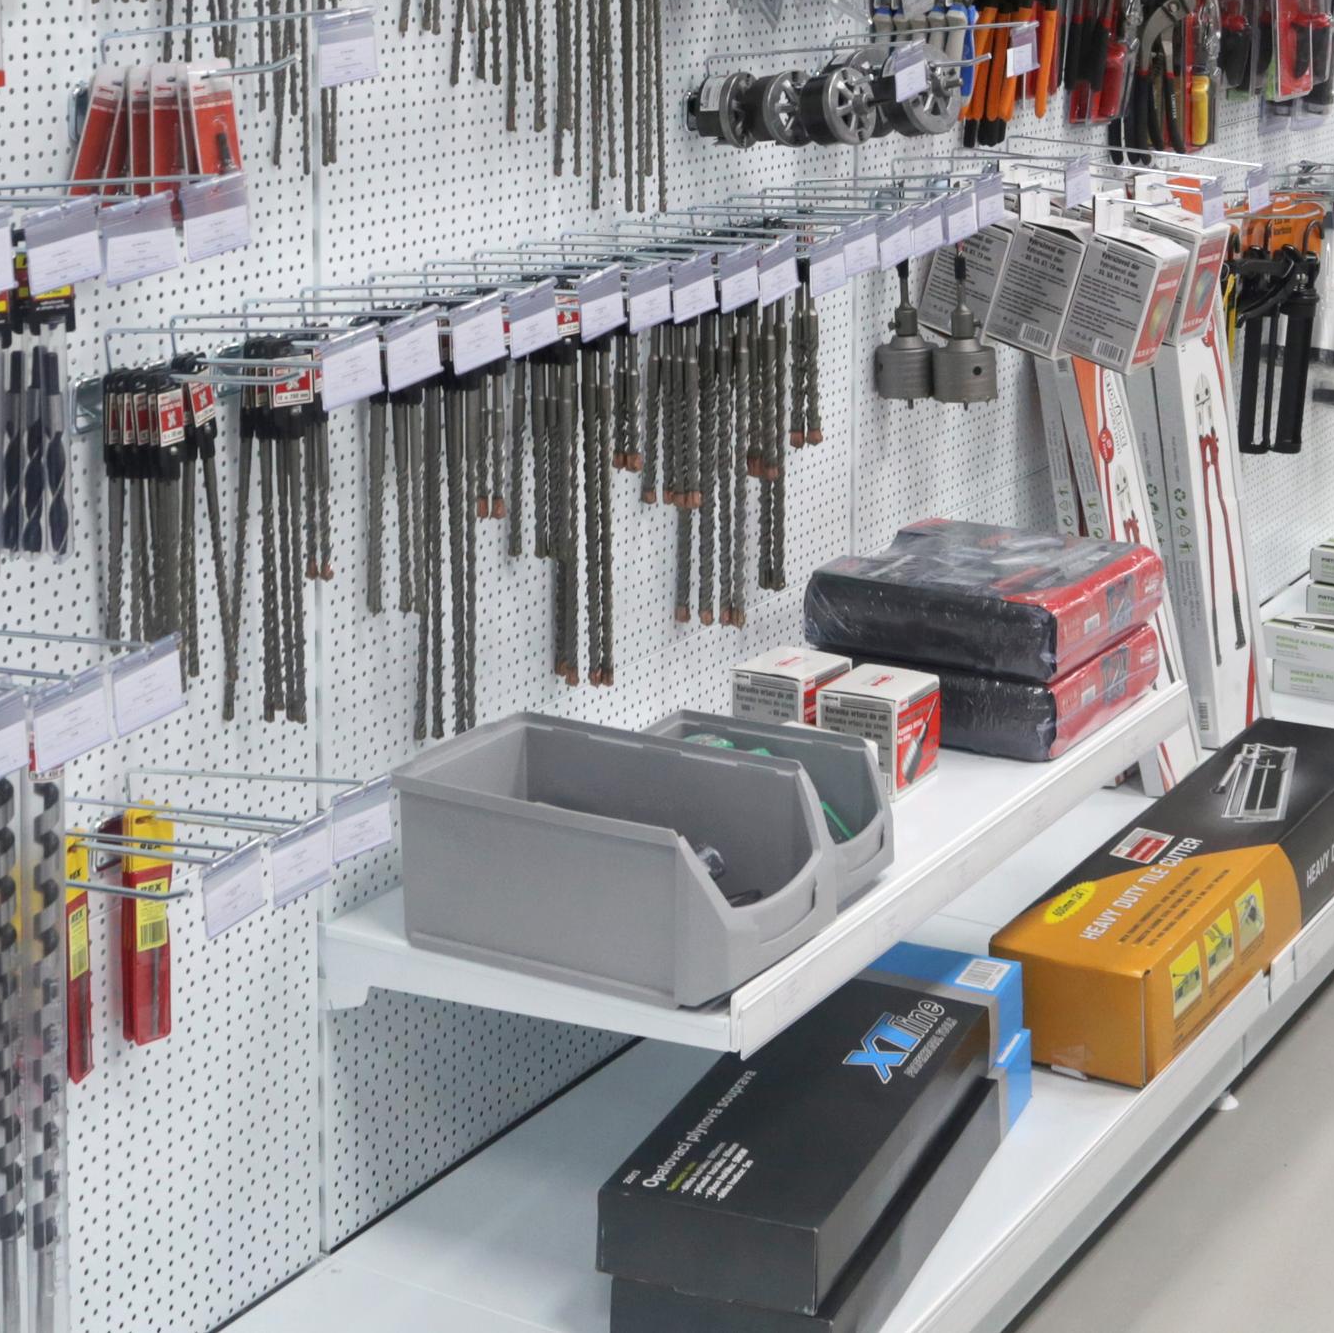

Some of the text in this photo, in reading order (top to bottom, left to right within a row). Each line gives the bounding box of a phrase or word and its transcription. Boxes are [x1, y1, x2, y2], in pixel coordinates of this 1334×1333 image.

[1079, 908, 1122, 941] HEAVY
[1112, 883, 1148, 910] DUTY
[1138, 866, 1170, 885] TILE
[1158, 837, 1204, 868] CUTTER
[1306, 852, 1329, 889] HEAVY
[842, 1000, 946, 1084] XTline
[686, 1108, 724, 1143] plynová
[716, 1070, 758, 1108] souprava
